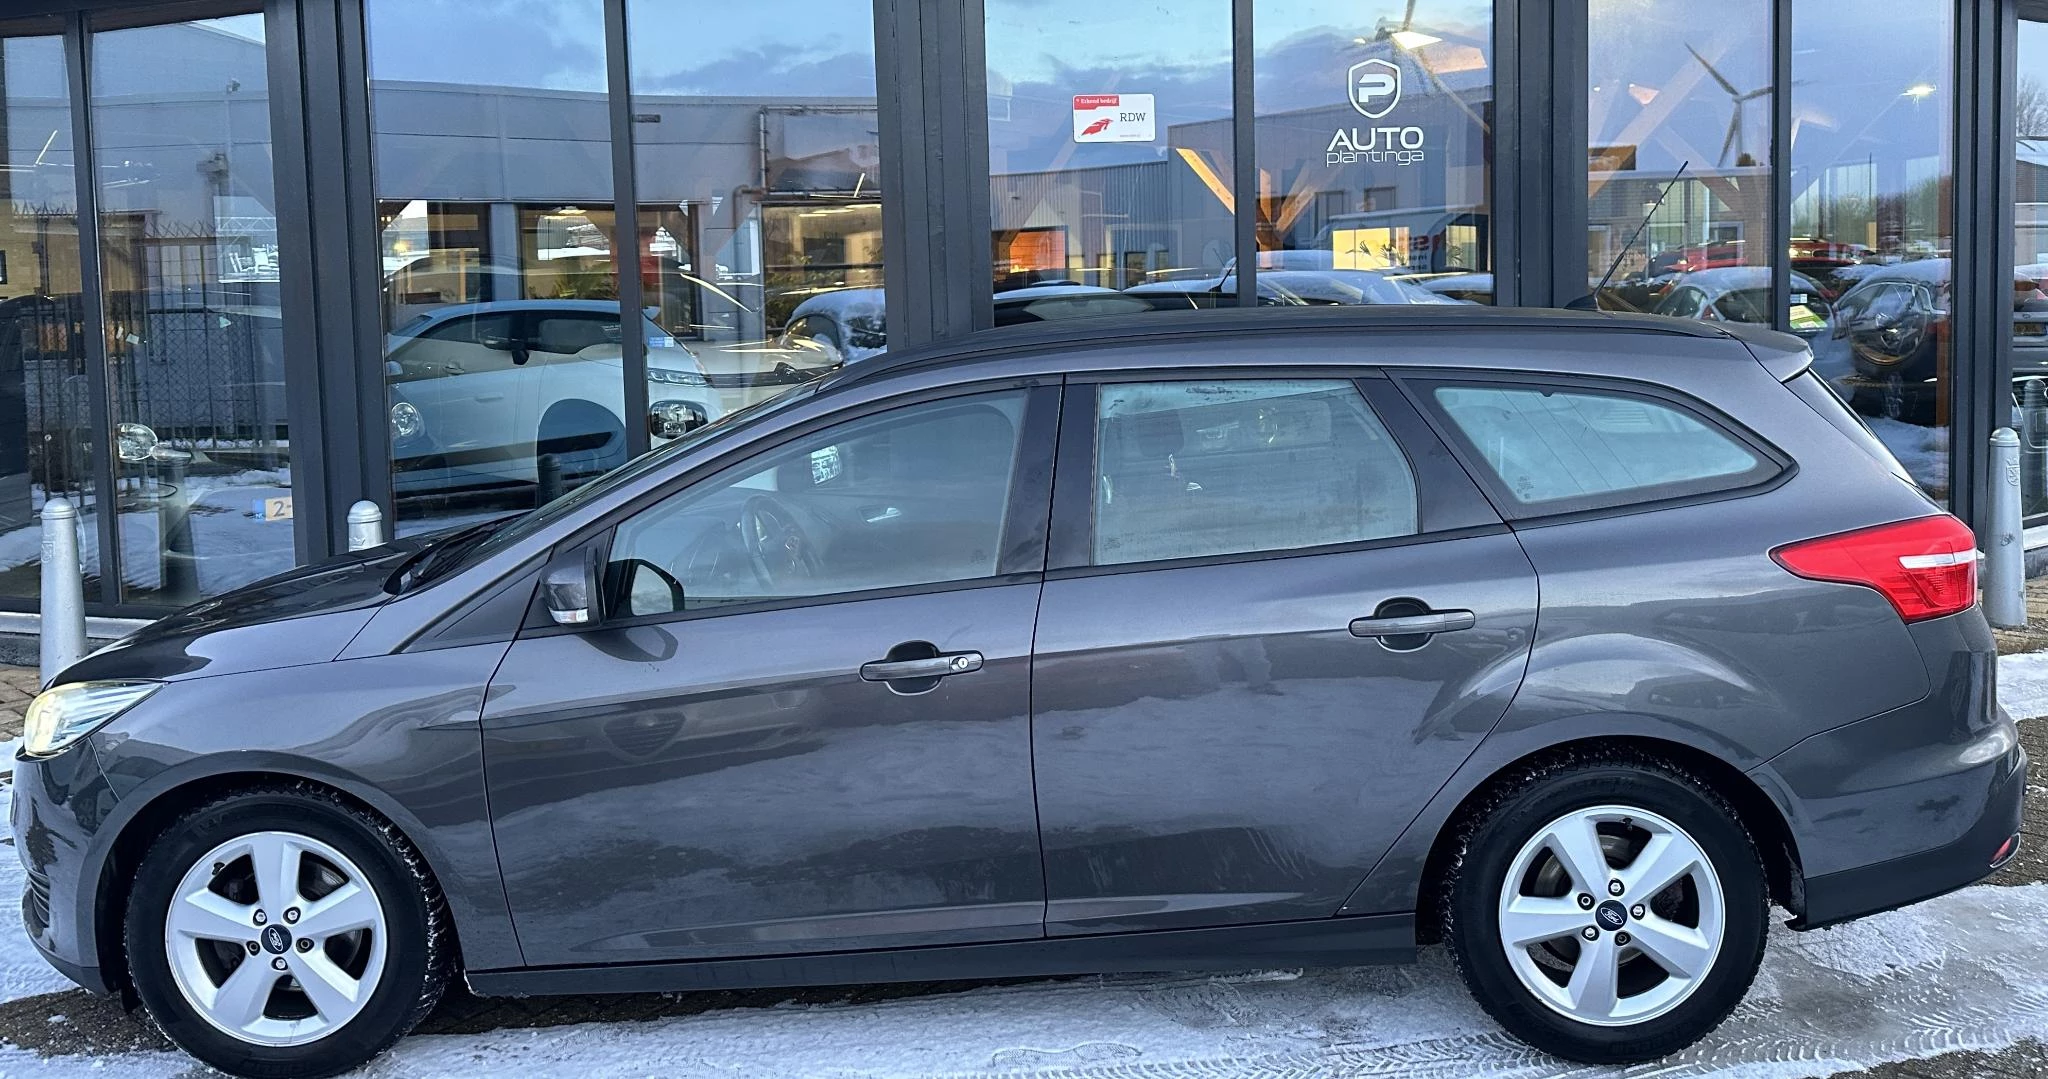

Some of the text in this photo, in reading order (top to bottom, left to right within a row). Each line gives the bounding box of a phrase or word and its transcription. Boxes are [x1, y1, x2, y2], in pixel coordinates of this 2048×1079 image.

[1358, 73, 1396, 103] P
[1119, 112, 1146, 122] RDW
[1326, 126, 1424, 151] AUTO
[1326, 149, 1424, 168] plantinga
